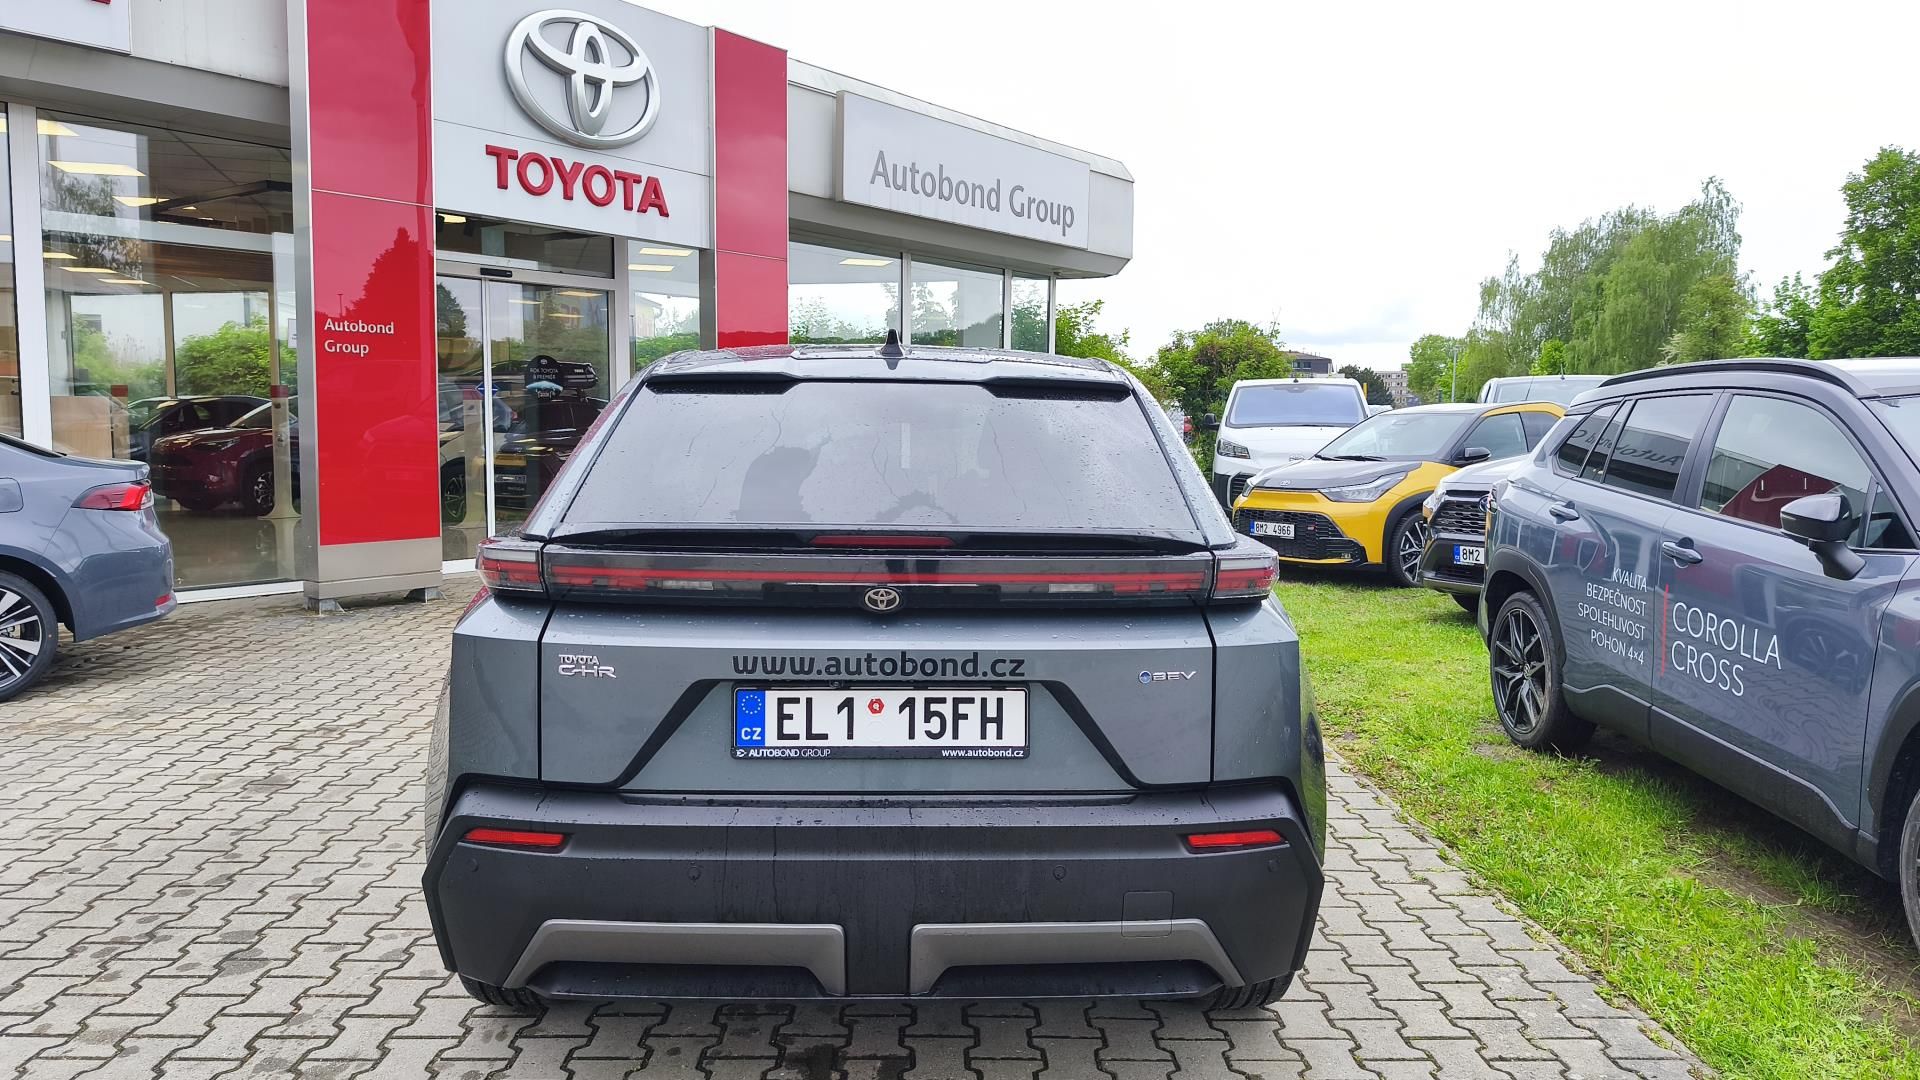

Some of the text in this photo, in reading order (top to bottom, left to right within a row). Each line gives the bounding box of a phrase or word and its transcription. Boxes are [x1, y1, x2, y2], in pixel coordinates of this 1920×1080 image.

[485, 144, 670, 218] TOYOTA
[870, 150, 1075, 237] Autobond Group
[324, 318, 395, 335] Autobond
[324, 339, 370, 358] Group
[1273, 525, 1291, 536] 4966
[1612, 567, 1647, 593] KVALITA
[1586, 582, 1647, 617] BEZPEČNOST
[1577, 602, 1646, 641] SPOLEHLIVOST
[1591, 629, 1626, 657] POHON
[1673, 602, 1782, 670] COROLLA
[558, 654, 600, 665] TOYOTA
[558, 664, 617, 679] C-HR
[732, 651, 1026, 678] www.autobond.cz
[1671, 640, 1744, 697] CROSS
[1152, 670, 1197, 681] BEV
[777, 697, 1004, 741] EL1 15FH
[741, 727, 762, 741] CZ
[748, 749, 831, 758] AUTOBOND GROUP
[941, 748, 1025, 758] www.autobond.cz
